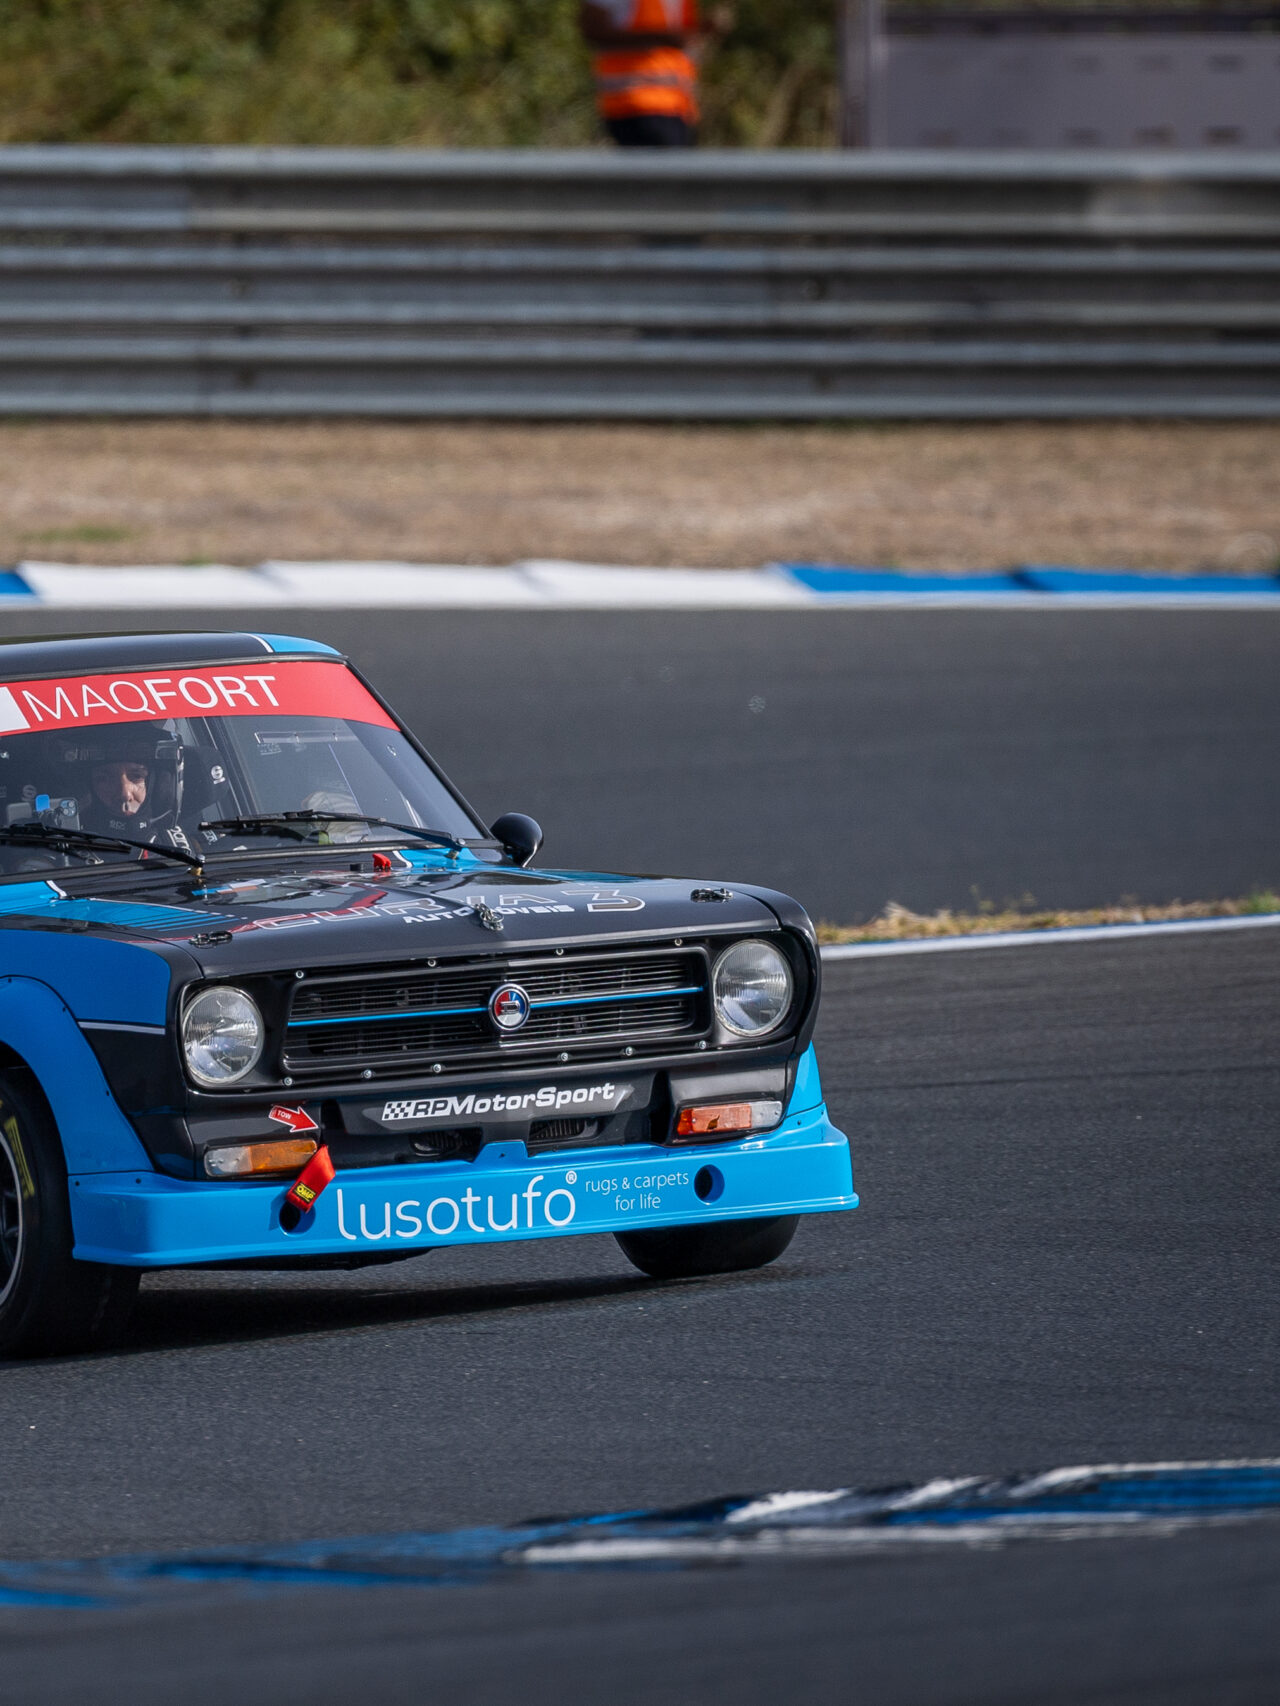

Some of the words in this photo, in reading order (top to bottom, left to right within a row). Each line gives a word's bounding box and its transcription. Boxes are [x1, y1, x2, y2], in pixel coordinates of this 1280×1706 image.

[21, 675, 281, 722] MAQFORT
[560, 889, 646, 913] 3
[277, 1110, 292, 1120] TOW
[296, 1184, 315, 1201] OMP
[585, 1178, 618, 1196] rugs
[621, 1176, 630, 1190] &
[633, 1171, 689, 1190] carpets
[615, 1194, 635, 1211] for
[640, 1192, 661, 1209] life
